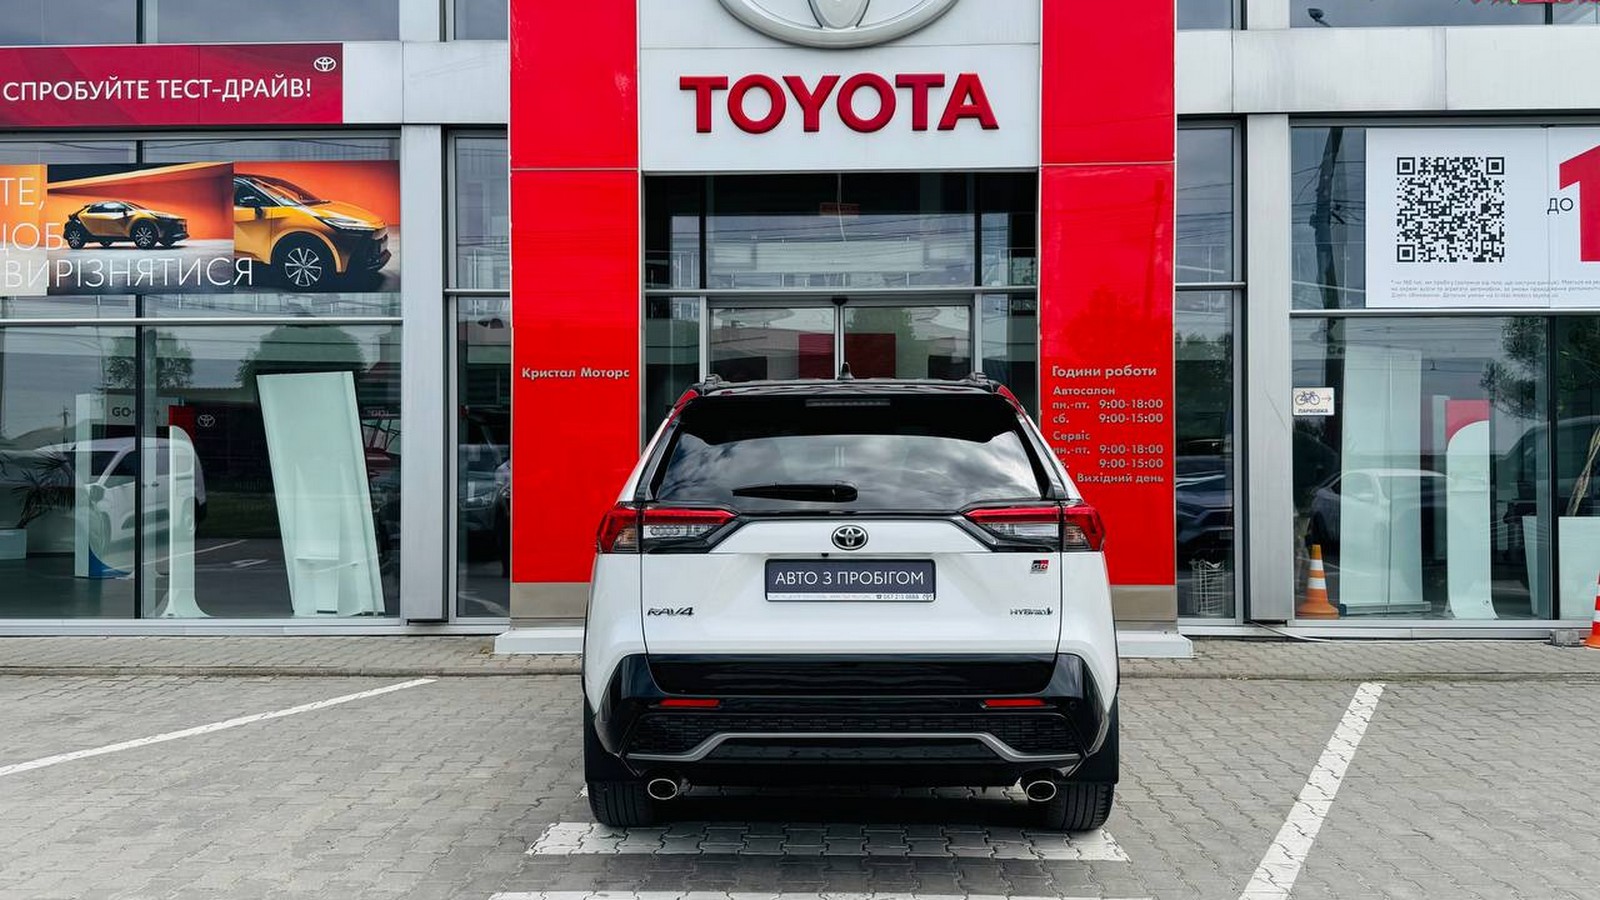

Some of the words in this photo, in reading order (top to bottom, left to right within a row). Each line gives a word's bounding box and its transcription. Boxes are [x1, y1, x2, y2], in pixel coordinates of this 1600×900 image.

[3, 76, 149, 101] СПРОБУЙТЕ
[157, 74, 311, 102] ТЕСТ-ДРАЙВ!
[679, 72, 999, 134] TOYOTA
[2, 222, 64, 255] ОБ
[5, 257, 253, 288] ВИРІЗНЯТИСЯ
[521, 367, 576, 380] Кристал
[580, 367, 630, 380] Моторс
[1052, 365, 1101, 378] Години
[1105, 364, 1157, 379] роботи
[1053, 386, 1115, 395] Автосалон
[1099, 399, 1163, 409] 9:00-18:00
[1053, 413, 1069, 423] сб.
[1099, 413, 1163, 423] 9:00-15:00
[1053, 430, 1090, 442] Сервіс
[1100, 444, 1164, 454] 9:00-18:00
[1100, 459, 1164, 468] 9:00-15:00
[1077, 472, 1132, 483] Вихідний
[1136, 474, 1164, 483] день
[775, 571, 818, 585] АВТО
[837, 571, 924, 585] ПРОБІГОМ
[647, 607, 694, 616] RAV4
